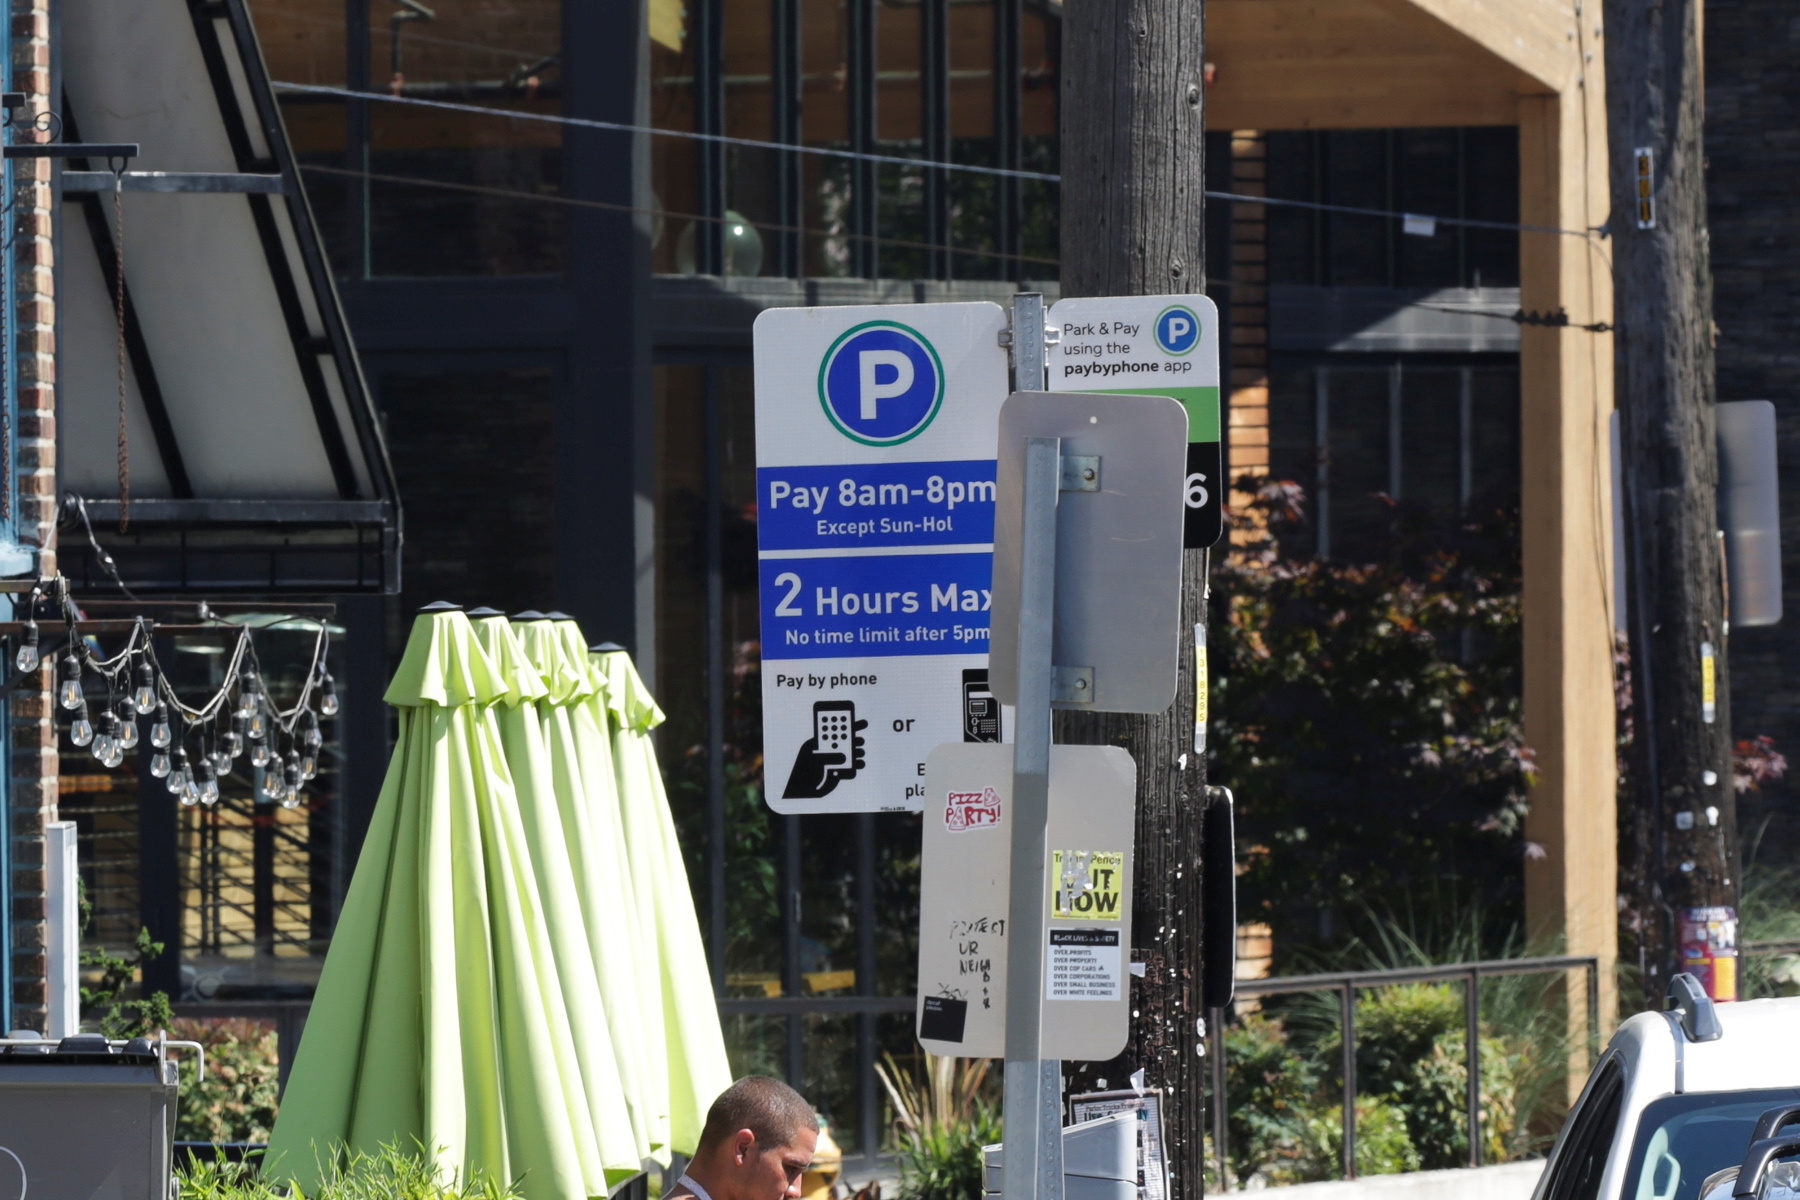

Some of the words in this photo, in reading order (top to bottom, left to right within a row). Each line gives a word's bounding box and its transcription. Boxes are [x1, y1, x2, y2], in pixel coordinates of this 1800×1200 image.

[1063, 322, 1095, 336] Park
[1099, 322, 1110, 335] &
[1113, 321, 1140, 337] Pay
[1063, 342, 1103, 358] using
[1106, 341, 1131, 354] the
[1064, 360, 1160, 378] paybyphone
[1163, 360, 1193, 375] app
[859, 349, 916, 421] P
[770, 480, 830, 515] Pay
[838, 475, 997, 510] 8am-8pm
[816, 518, 876, 537] Except
[880, 515, 954, 534] Sun-Hol
[774, 571, 803, 617] 2
[815, 585, 920, 616] Hours
[930, 582, 993, 613] Max
[785, 629, 810, 645] No
[814, 628, 855, 644] time
[859, 626, 901, 643] limit
[904, 625, 949, 642] after
[953, 624, 991, 643] 5pm
[776, 674, 804, 690] Pay
[808, 673, 826, 689] by
[830, 672, 878, 690] phone
[892, 718, 916, 733] or
